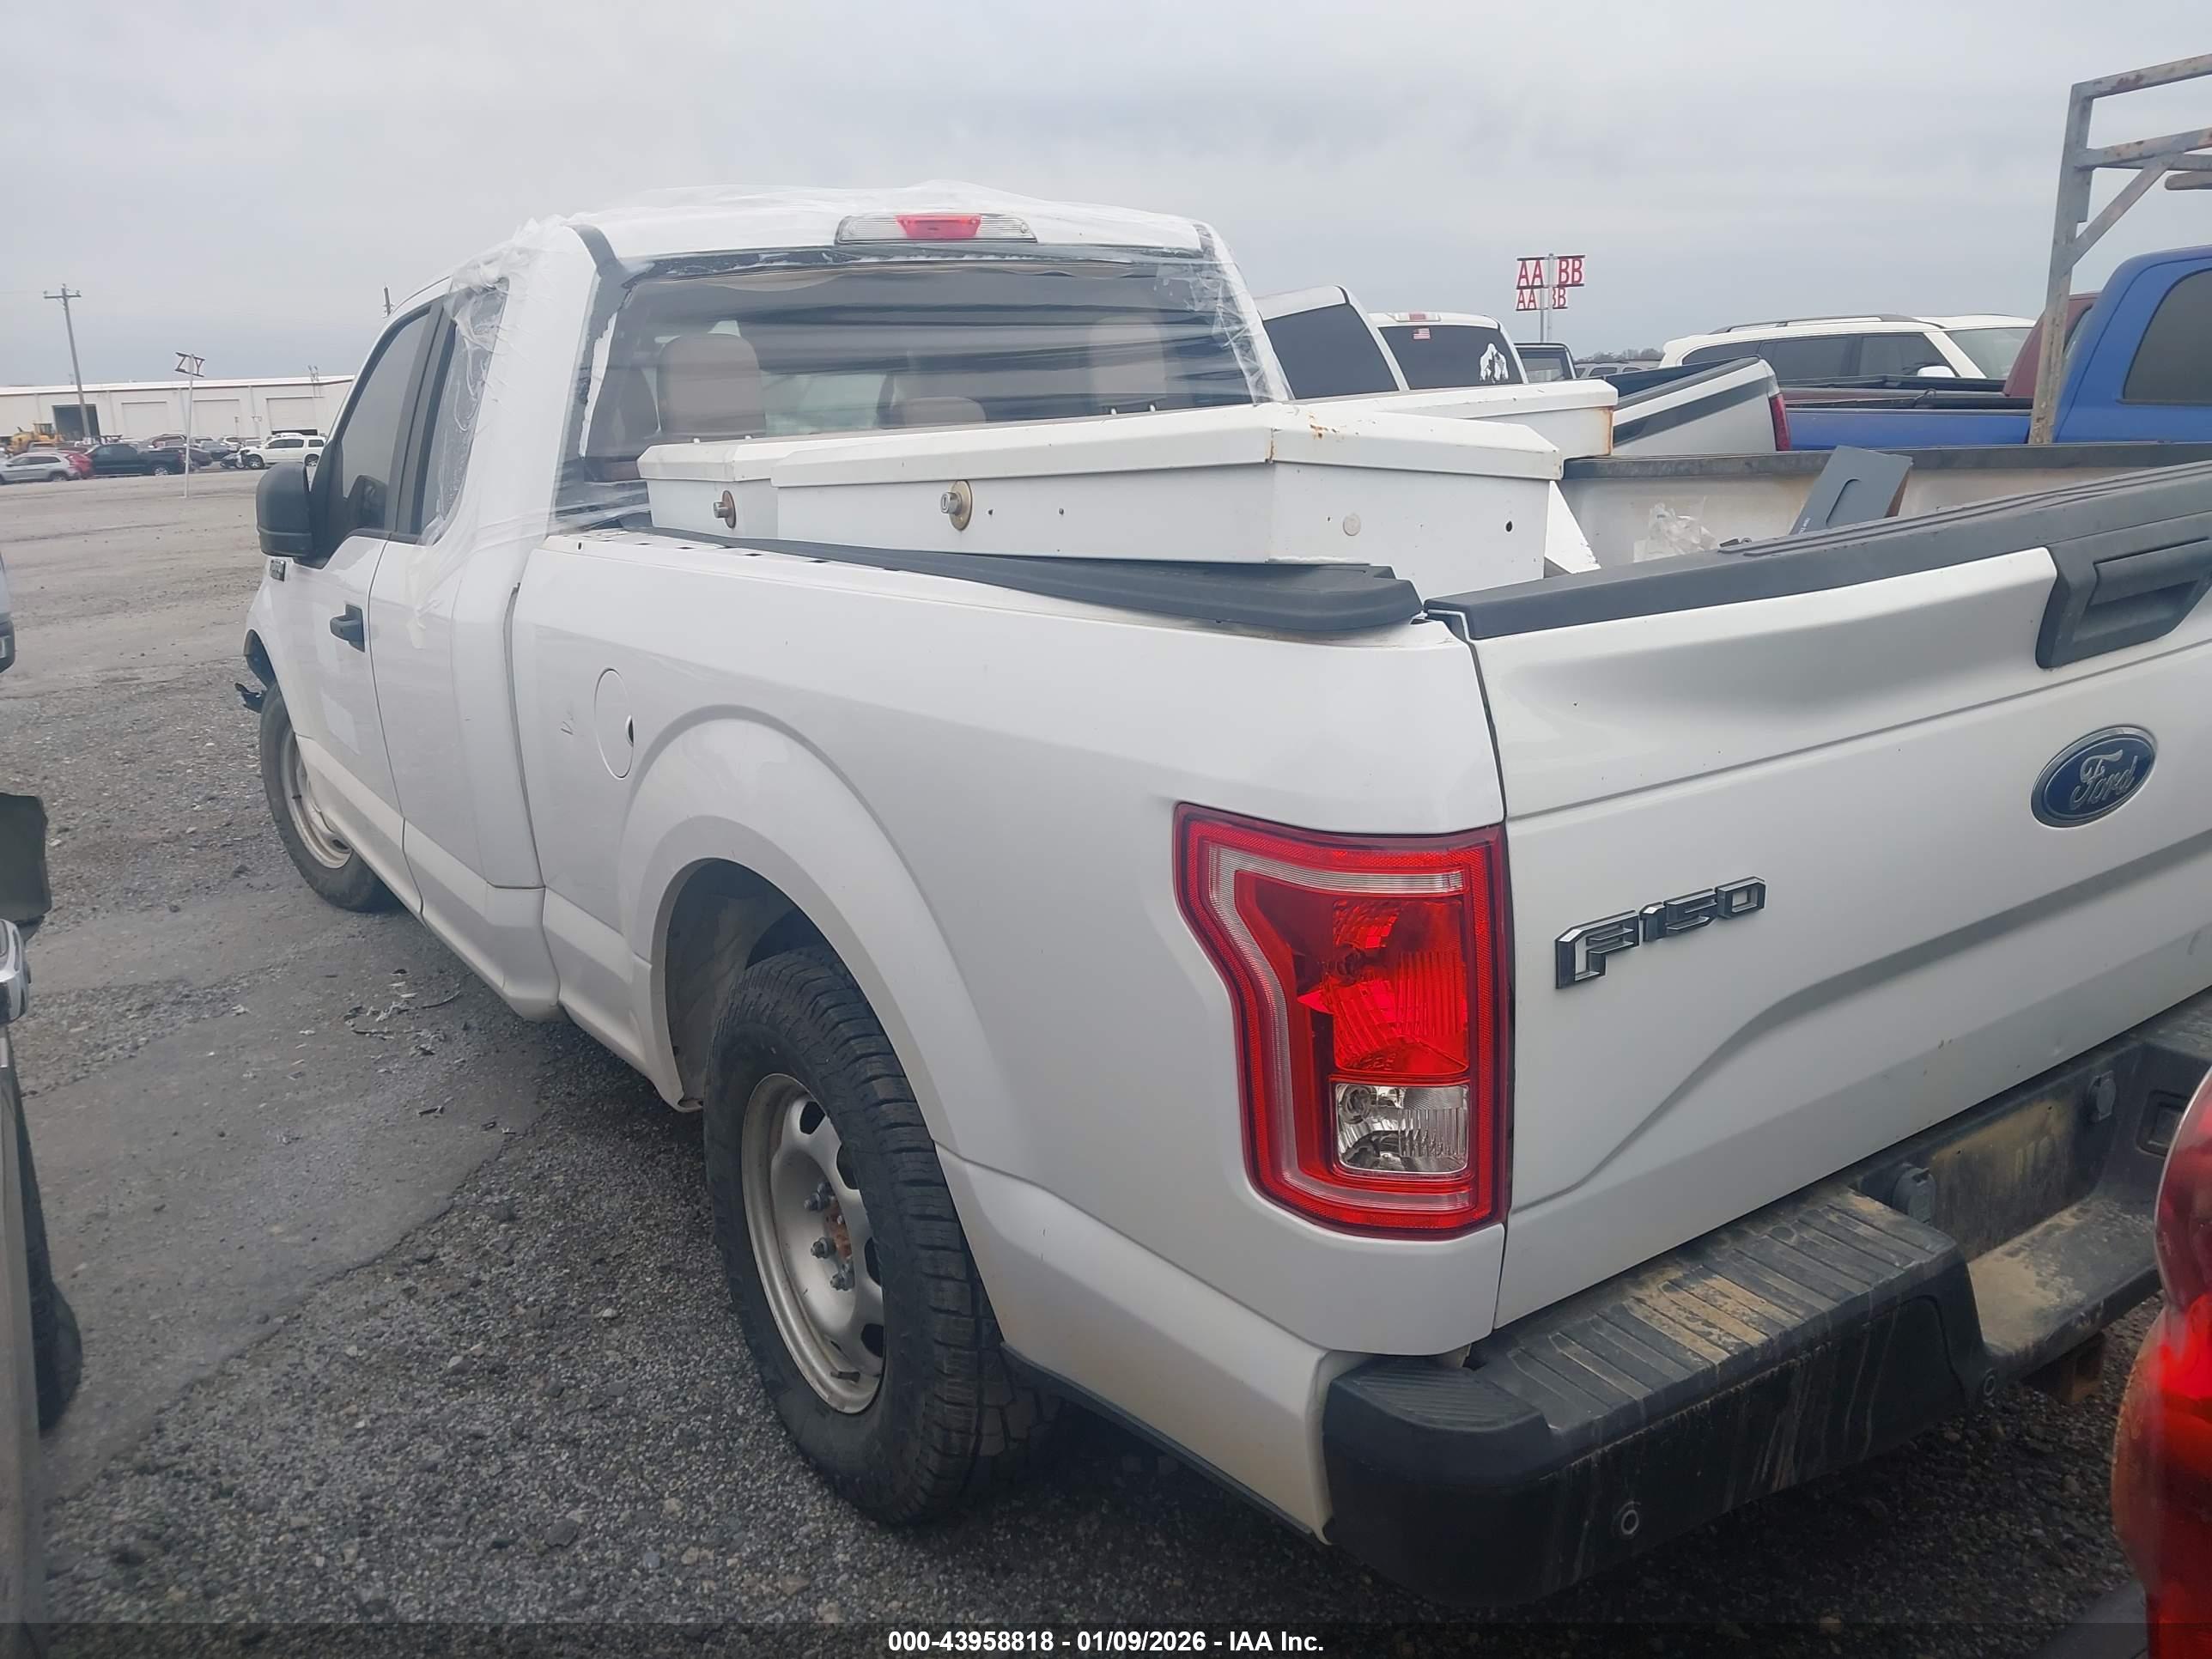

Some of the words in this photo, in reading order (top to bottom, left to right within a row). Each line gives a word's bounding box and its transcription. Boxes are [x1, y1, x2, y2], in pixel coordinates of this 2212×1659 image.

[1517, 259, 1544, 287] AA
[1559, 258, 1583, 285] BB
[1516, 289, 1537, 309] AA
[2069, 749, 2139, 811] Ford
